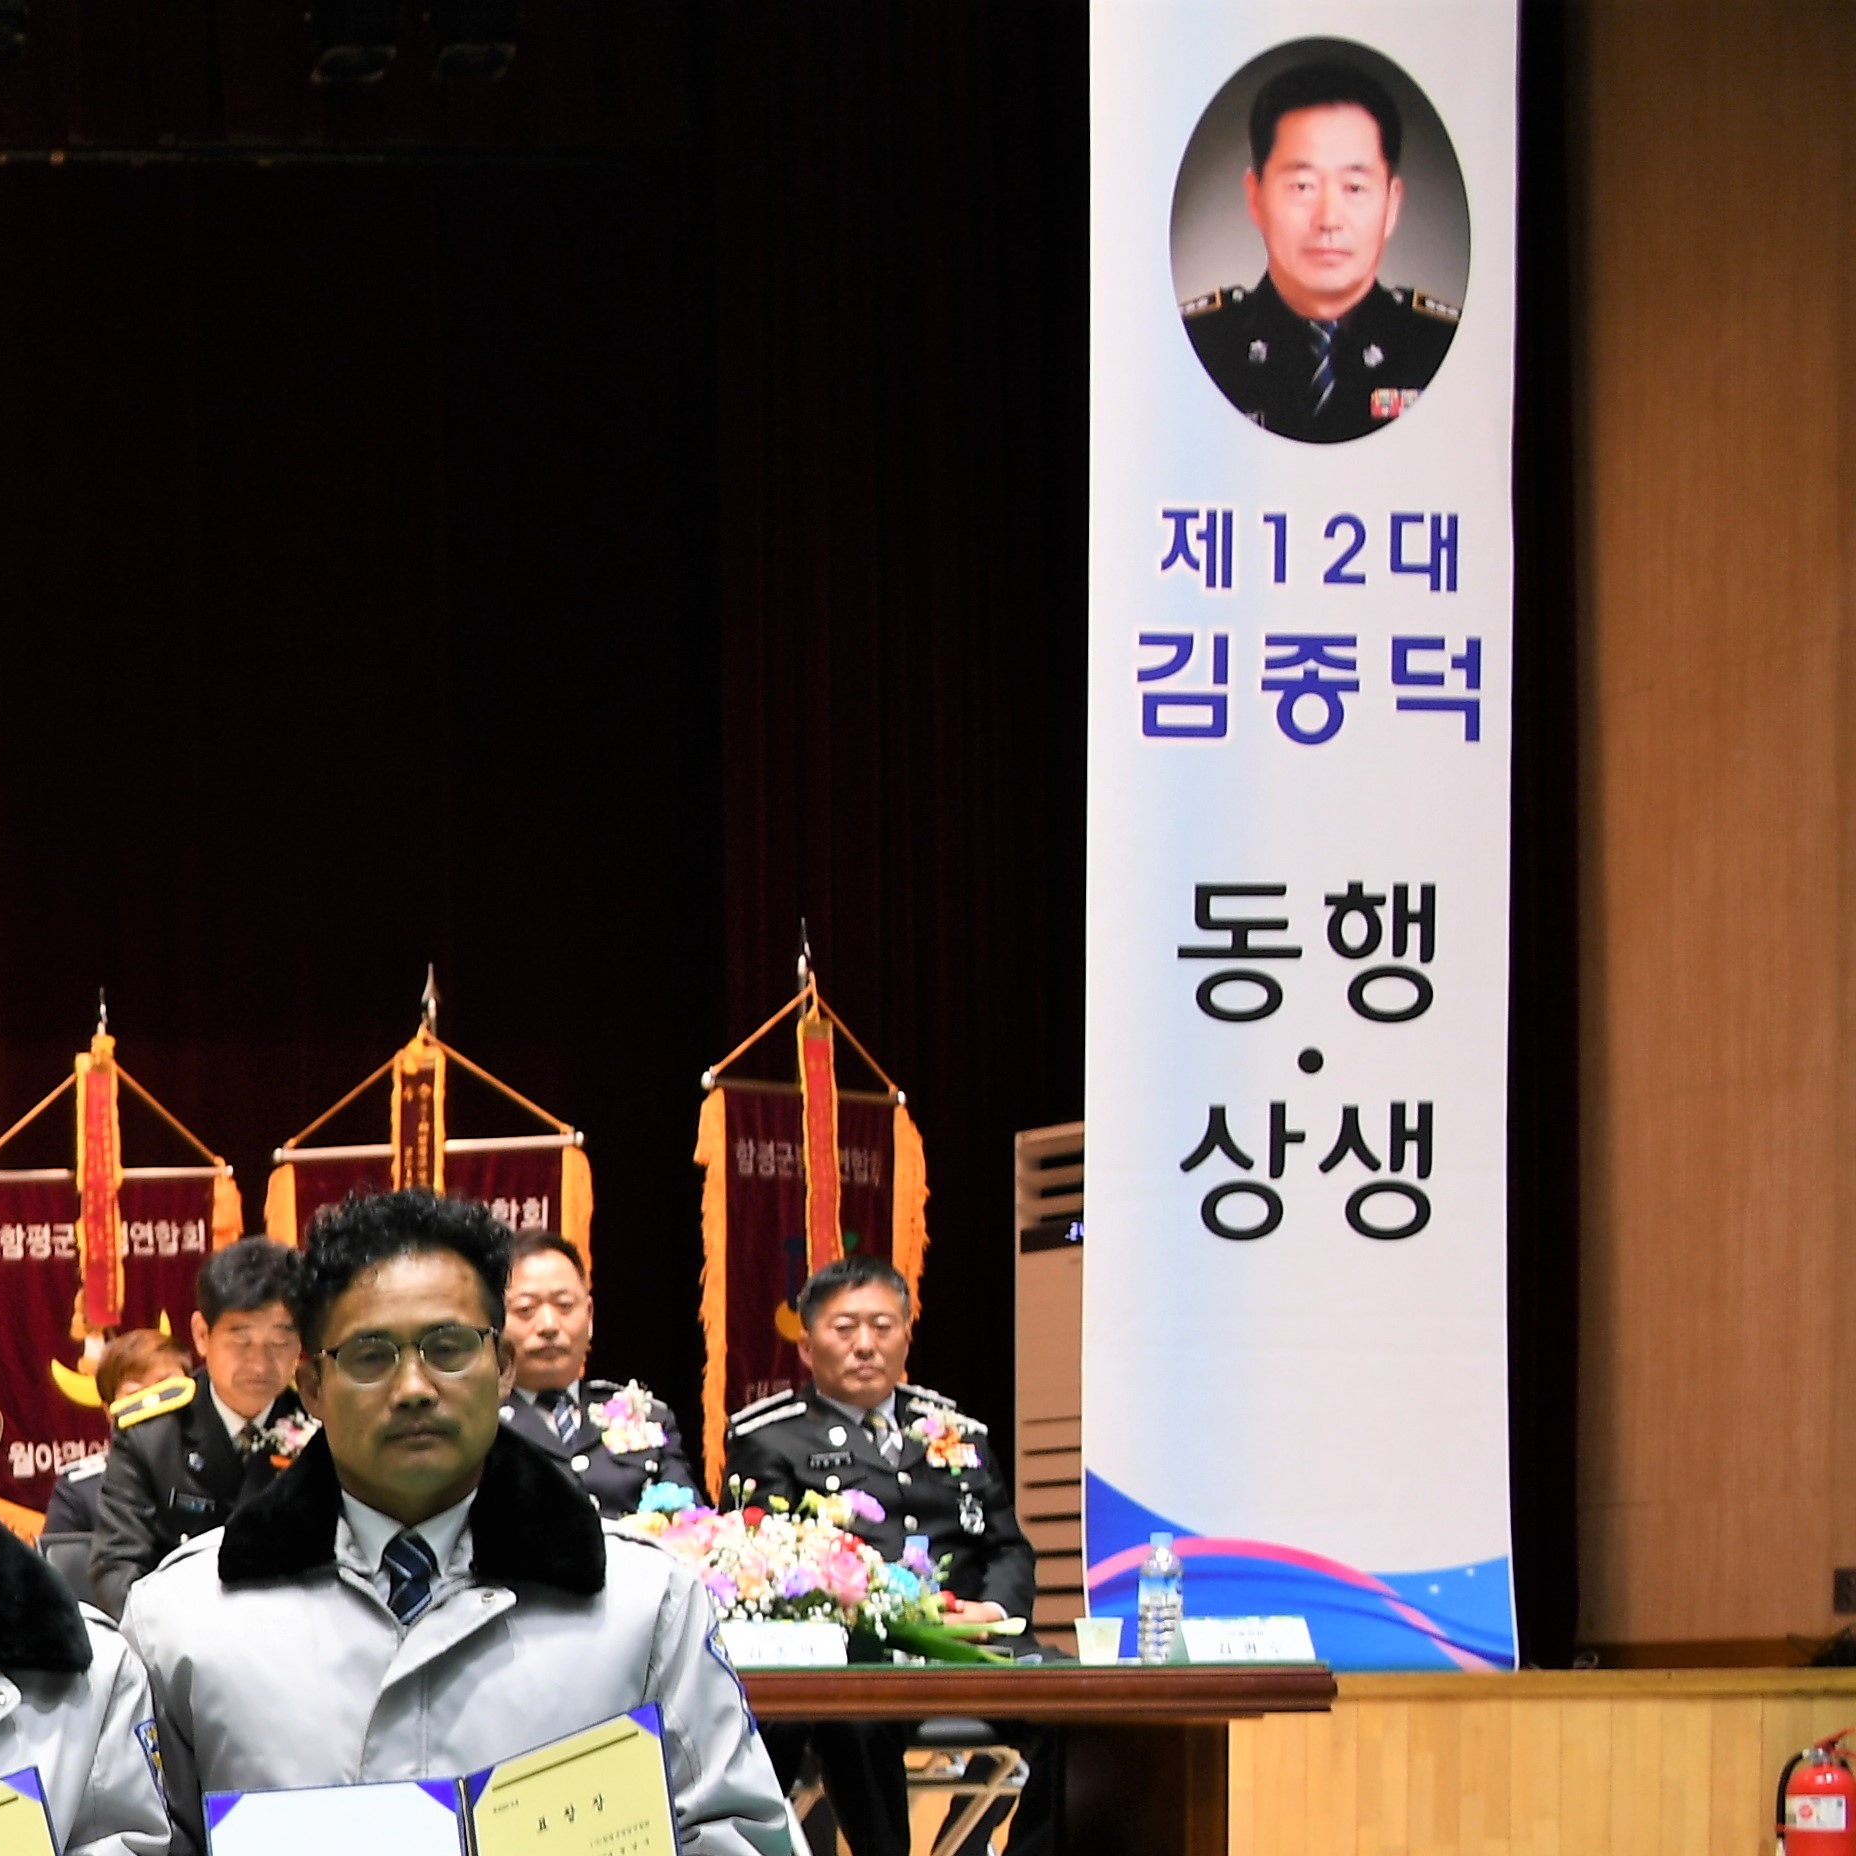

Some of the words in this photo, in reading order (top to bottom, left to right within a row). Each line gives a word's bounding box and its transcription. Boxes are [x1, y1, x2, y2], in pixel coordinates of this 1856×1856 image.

[1160, 507, 1460, 592] 제12대
[1137, 633, 1483, 745] 김종덕
[1177, 881, 1436, 1023] 동행
[1180, 1102, 1433, 1241] 상생
[0, 1218, 205, 1261] 함평군연합회
[8, 1440, 110, 1478] 월야면
